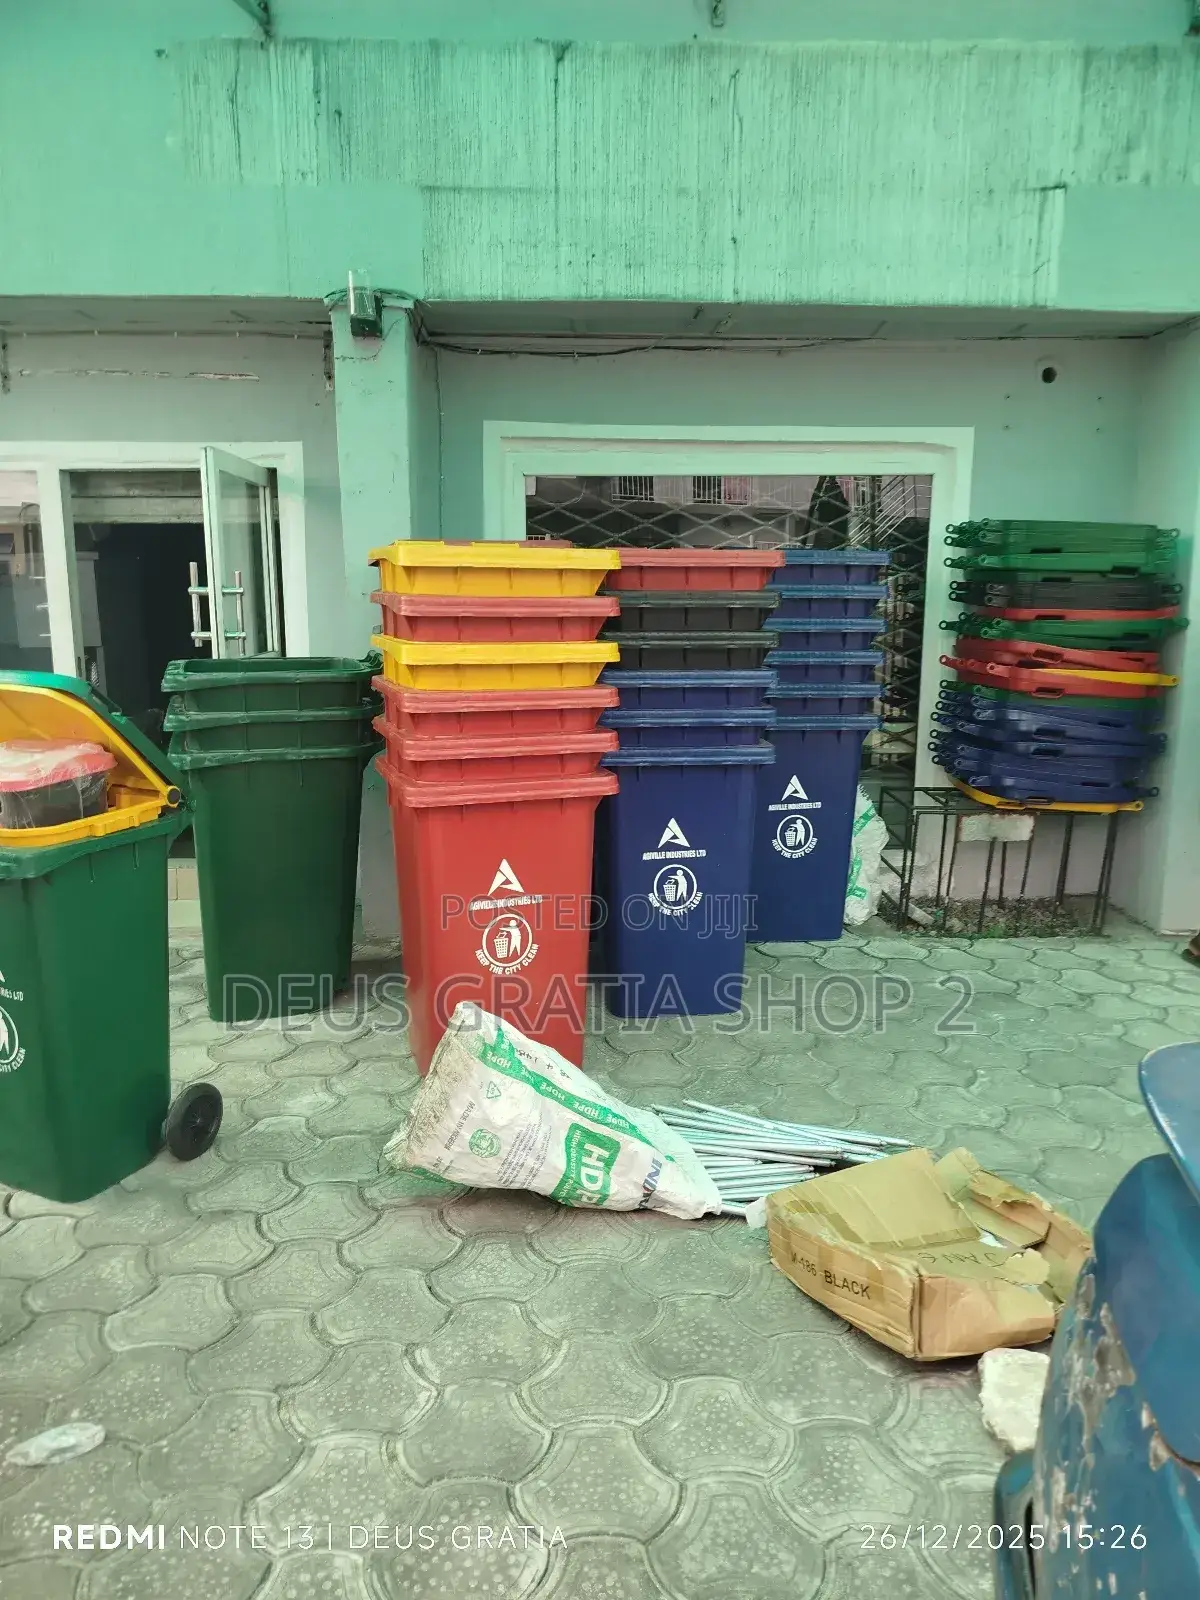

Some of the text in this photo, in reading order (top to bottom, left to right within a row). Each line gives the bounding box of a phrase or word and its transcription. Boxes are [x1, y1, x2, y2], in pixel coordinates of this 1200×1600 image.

[666, 850, 696, 859] INDUSTRIES
[696, 849, 707, 858] LTD
[475, 943, 539, 975] KEEP THE CITY CLEAN
[486, 1052, 512, 1068] HDPE
[540, 1082, 566, 1101] HDPE
[573, 1101, 599, 1117] HDPE
[576, 1143, 610, 1204] HDP
[824, 1269, 871, 1300] BLACK
